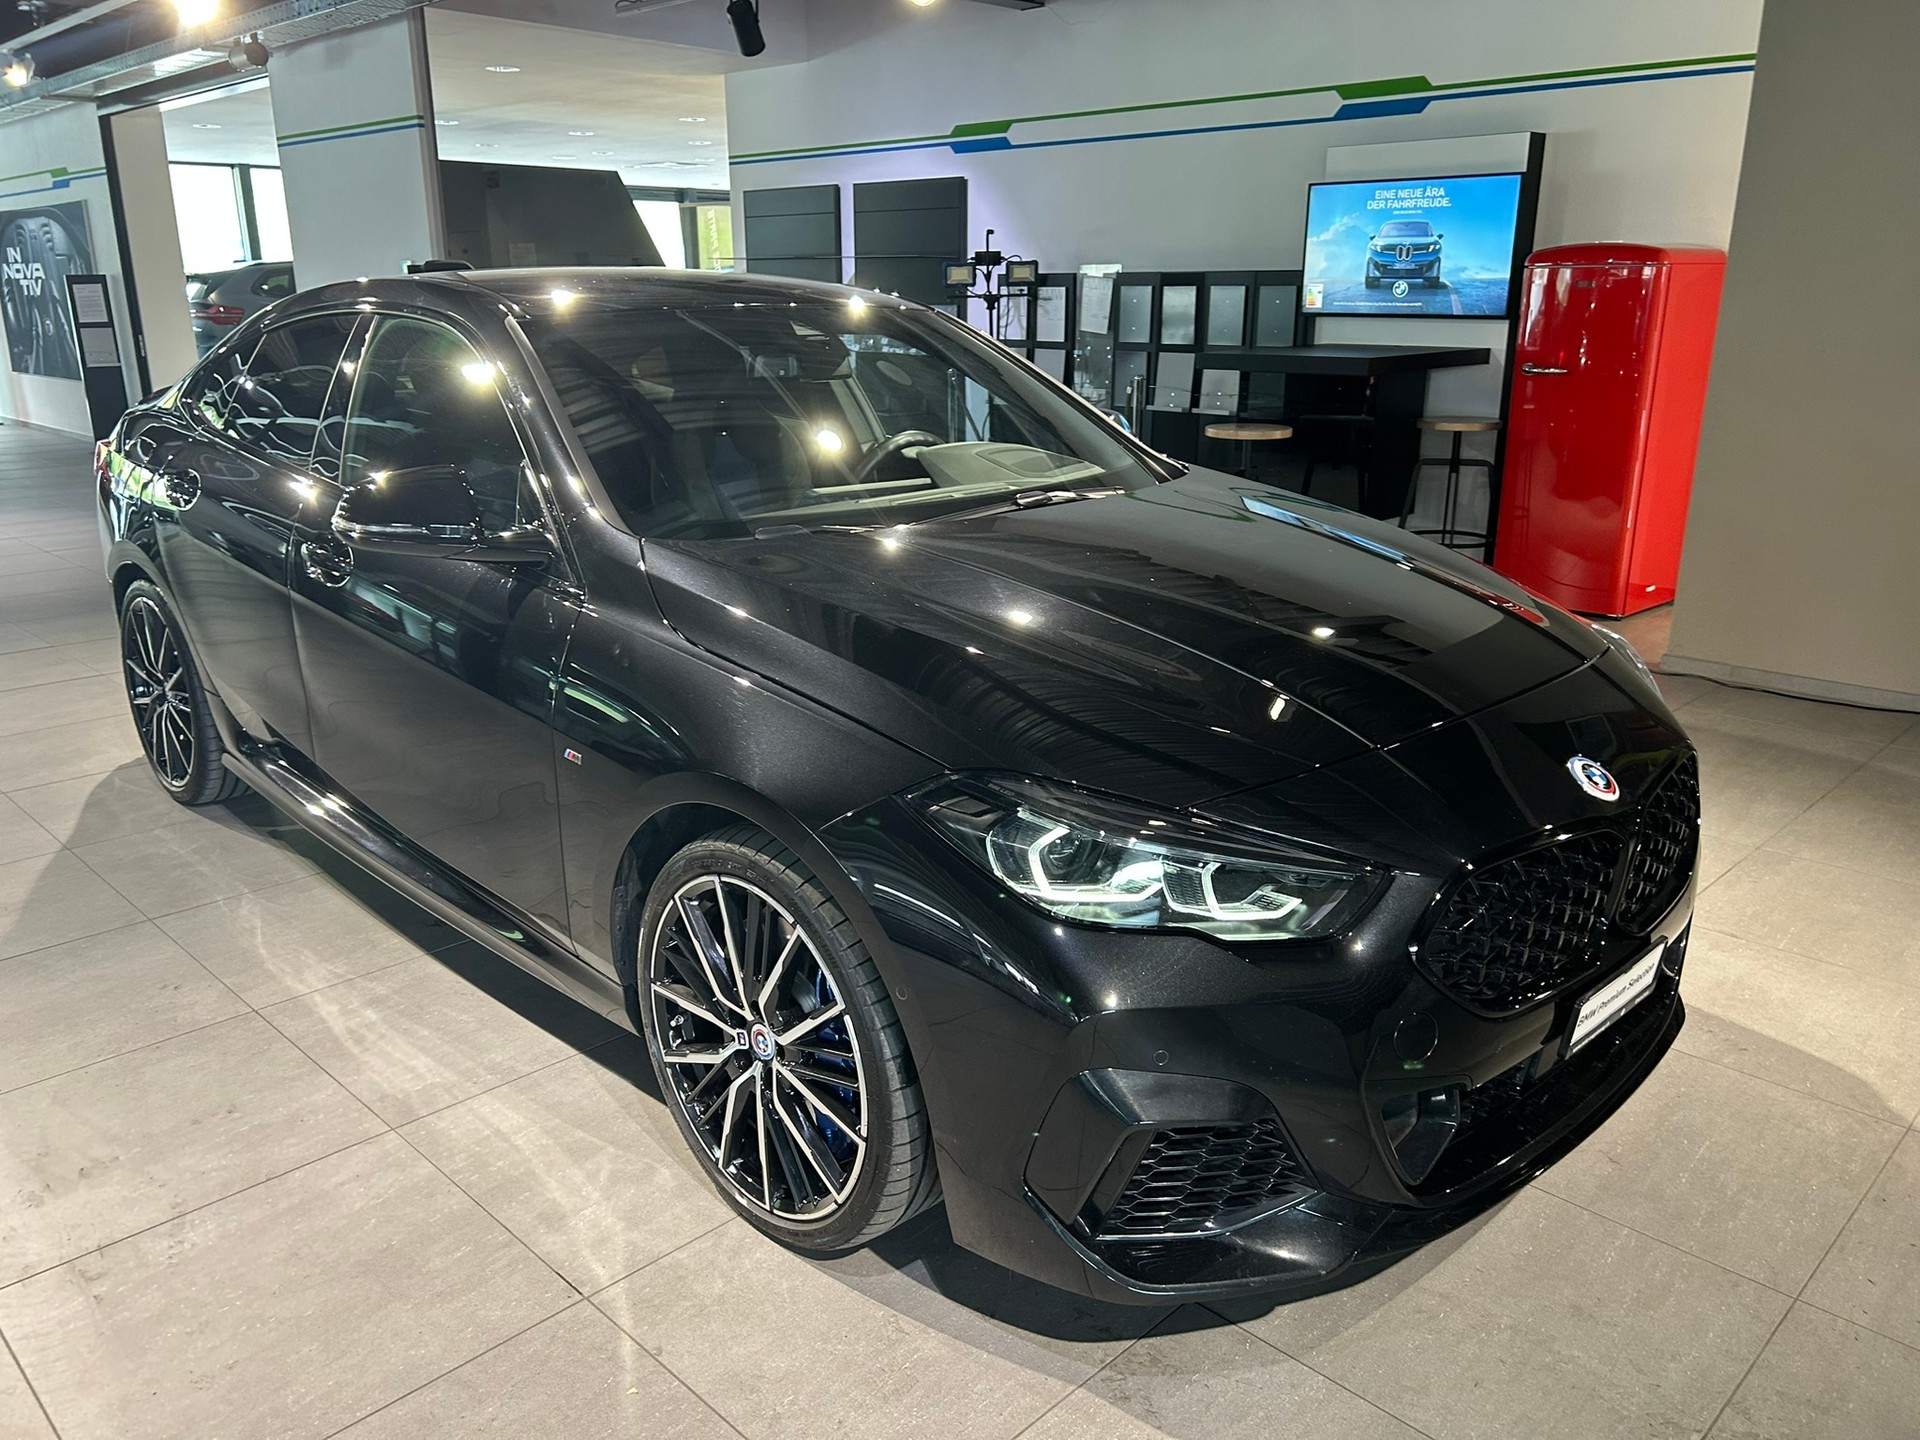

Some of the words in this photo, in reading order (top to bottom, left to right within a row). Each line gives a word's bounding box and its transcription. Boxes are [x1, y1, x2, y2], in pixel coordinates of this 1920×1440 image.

[1375, 189, 1396, 200] EINE
[1397, 187, 1424, 199] NEUE
[1366, 200, 1386, 210] DER
[1387, 197, 1452, 209] FAHRFREUDE.
[6, 246, 22, 263] IN
[2, 262, 46, 279] NOVA
[19, 279, 42, 296] TIV
